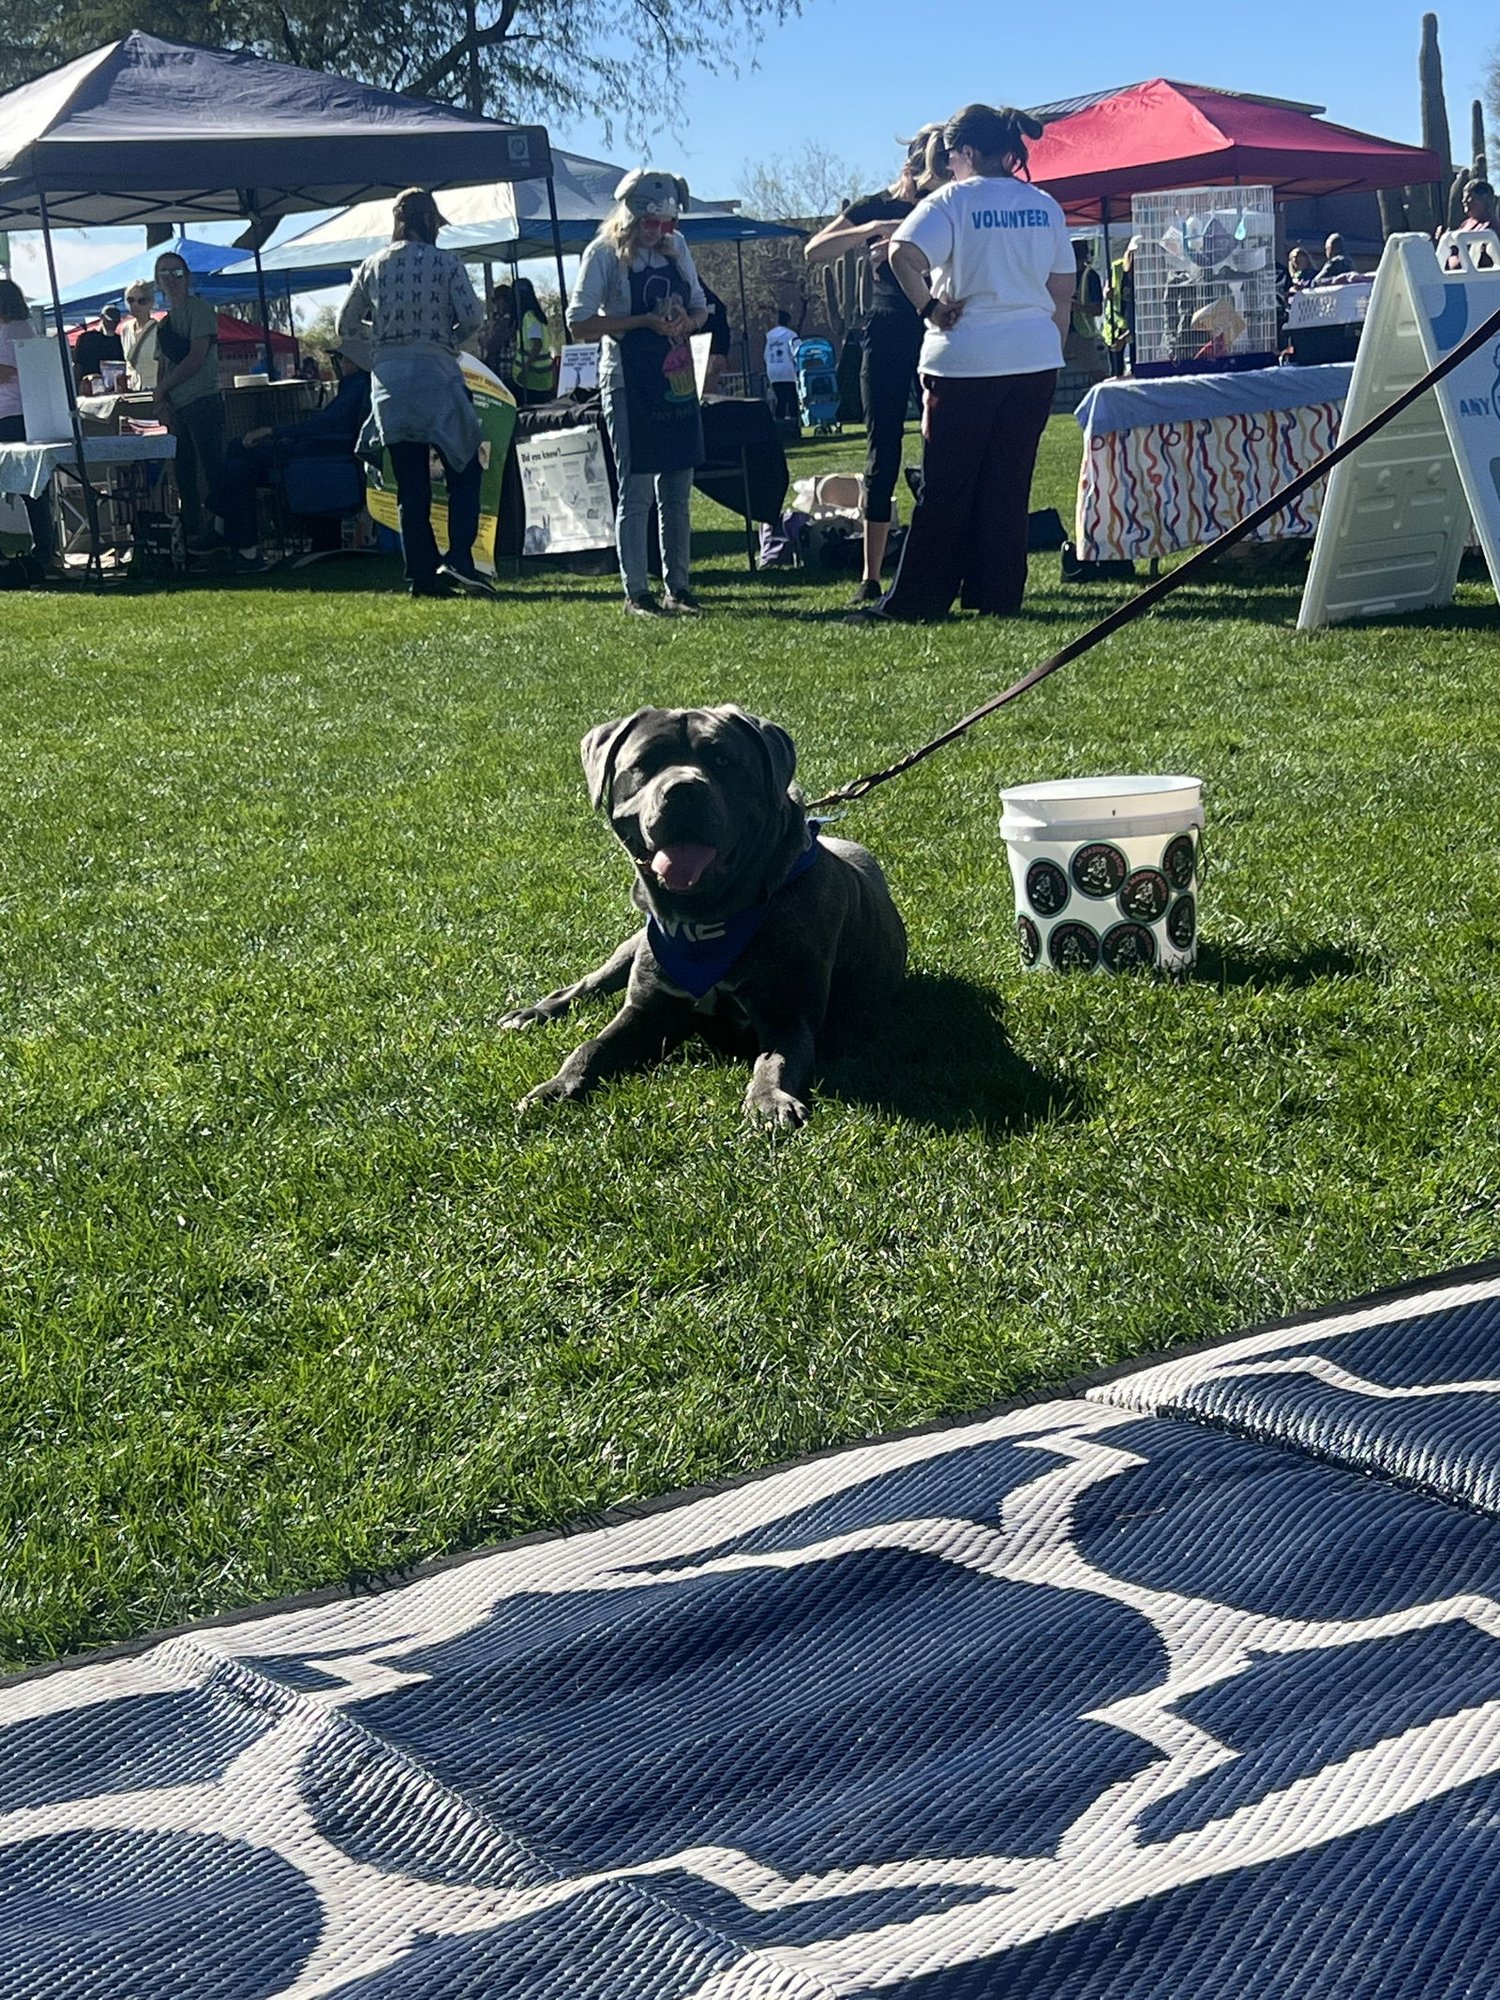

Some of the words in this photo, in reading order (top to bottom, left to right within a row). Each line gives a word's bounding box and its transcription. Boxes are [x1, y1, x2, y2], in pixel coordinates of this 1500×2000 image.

[972, 210, 1050, 229] VOLUNTEER
[1460, 398, 1490, 417] ANY
[521, 453, 531, 463] Did
